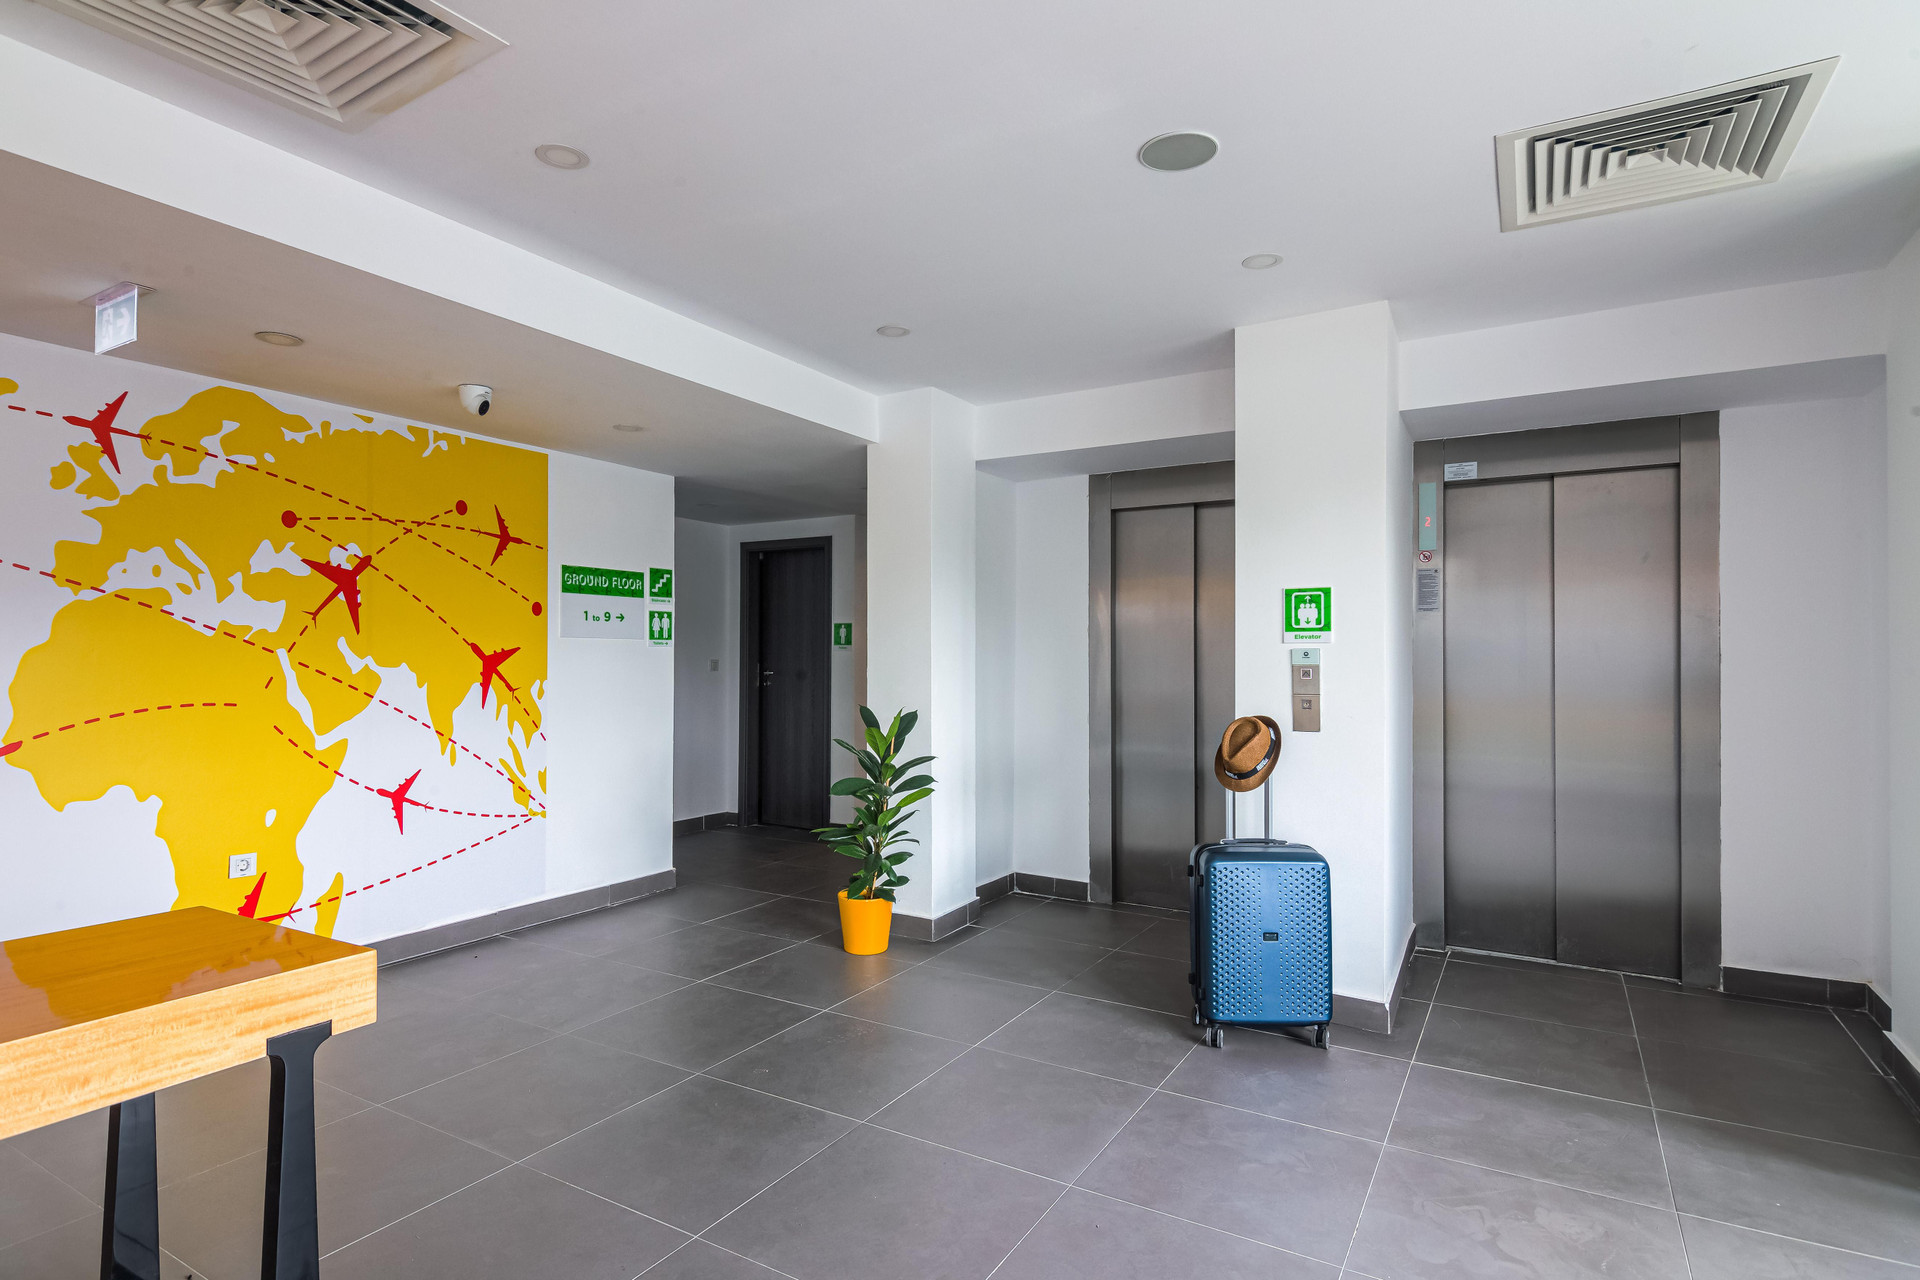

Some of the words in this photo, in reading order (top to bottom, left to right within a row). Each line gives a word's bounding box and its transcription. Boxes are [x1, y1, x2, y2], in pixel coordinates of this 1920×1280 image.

[1425, 516, 1431, 527] 2
[564, 573, 609, 588] GROUND
[612, 577, 642, 590] FLOOR
[583, 610, 588, 621] 1
[592, 614, 600, 622] to
[604, 611, 611, 622] 9
